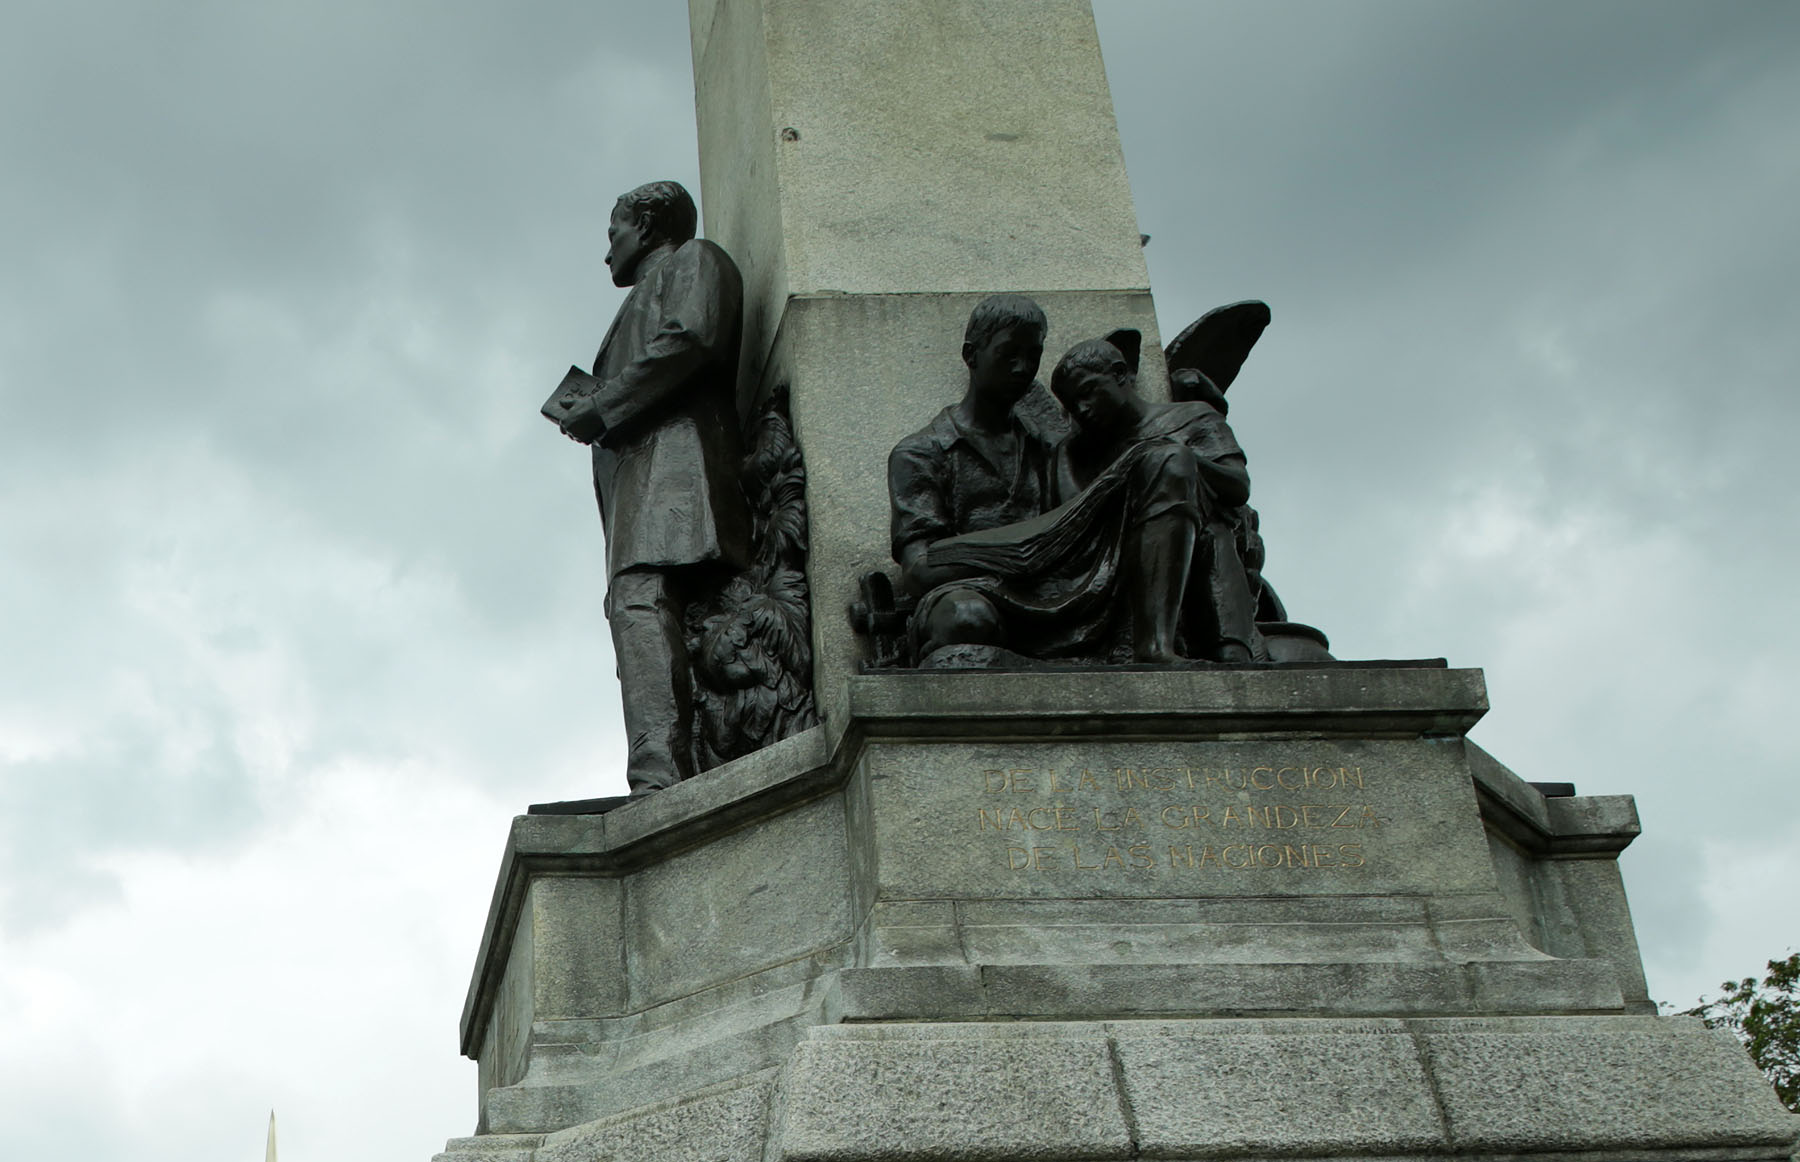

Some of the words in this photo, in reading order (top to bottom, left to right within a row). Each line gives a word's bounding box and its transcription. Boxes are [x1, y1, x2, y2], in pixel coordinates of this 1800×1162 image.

[984, 768, 1036, 793] DE
[1049, 768, 1100, 792] LA
[1115, 766, 1364, 793] INSTRUCCION
[978, 807, 1081, 831] NACE
[1093, 807, 1147, 831] LA
[1161, 804, 1380, 830] GRANDEZA
[1008, 847, 1059, 870] DE
[1073, 845, 1156, 870] LAS
[1168, 843, 1366, 869] NACIONES
